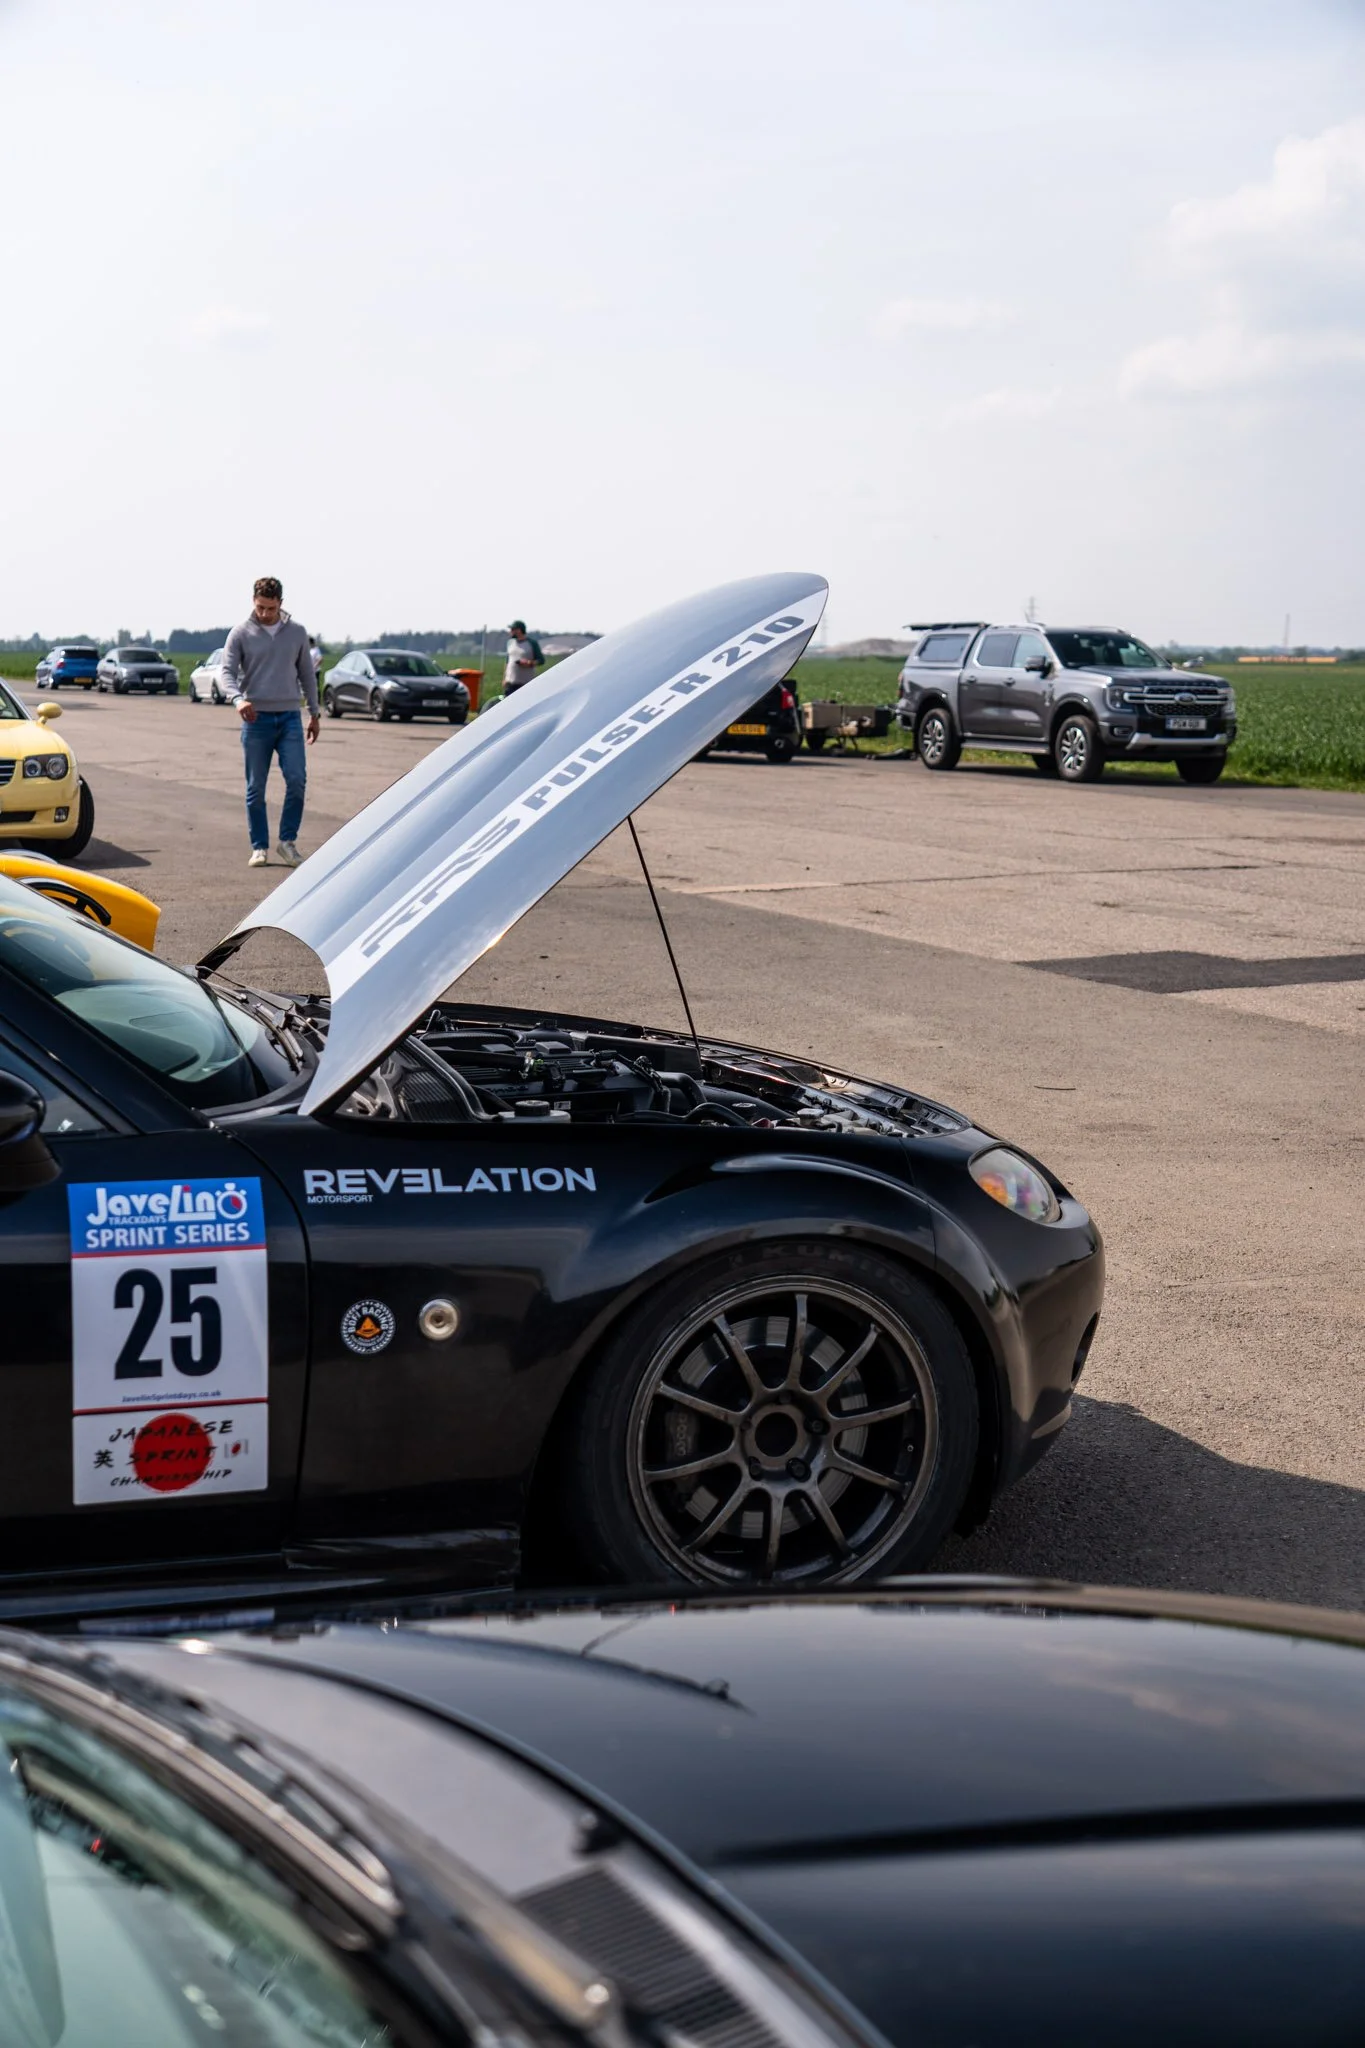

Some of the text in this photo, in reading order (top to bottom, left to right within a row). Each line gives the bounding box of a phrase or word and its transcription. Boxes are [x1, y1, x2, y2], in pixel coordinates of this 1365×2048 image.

[522, 672, 712, 811] PULSE-R
[712, 615, 805, 667] 210
[307, 1194, 373, 1204] MOTORSPORT
[108, 1215, 167, 1226] TRACKDAYS
[86, 1222, 250, 1249] SPRINT SERIES
[113, 1265, 222, 1380] 25
[362, 1306, 389, 1330] RACING
[108, 1419, 234, 1443] JAPANESE
[127, 1446, 217, 1466] SPRINT
[109, 1468, 233, 1487] CHAMPIONSHIP
